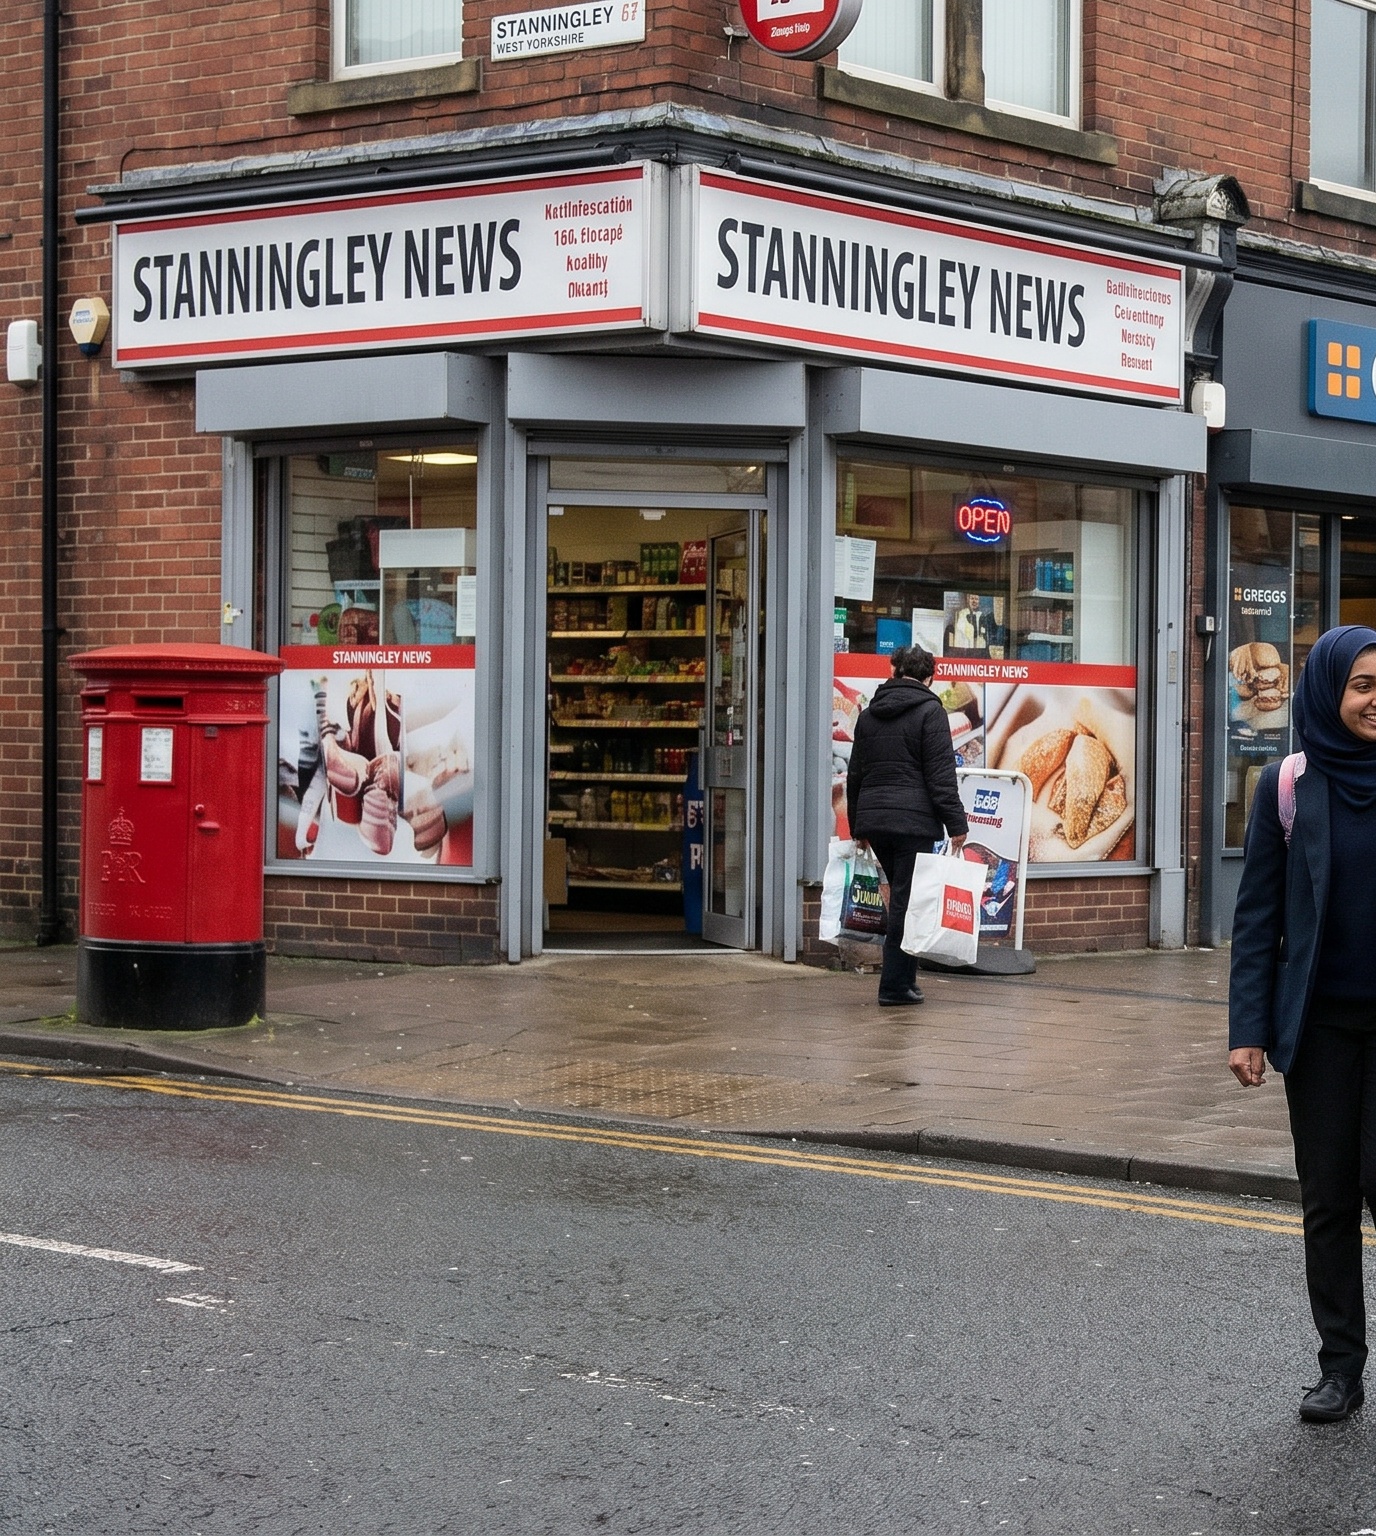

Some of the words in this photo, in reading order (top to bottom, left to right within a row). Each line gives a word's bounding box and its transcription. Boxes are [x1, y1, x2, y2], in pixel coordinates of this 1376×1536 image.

[497, 6, 613, 39] STANNINGLEY
[497, 40, 524, 54] WEST
[527, 32, 584, 51] YORKSHIRE
[133, 231, 392, 323] STANNINGLEY
[404, 218, 522, 300] NEWS
[716, 217, 981, 330] STANNINGLEY
[990, 267, 1086, 348] NEWS
[958, 506, 1011, 534] OPEN
[1243, 588, 1287, 604] GREGGS
[333, 651, 401, 664] STANNINGLEY
[402, 651, 432, 664] NEWS
[937, 663, 1001, 678] STANNINGLEY
[1001, 665, 1029, 679] NEWS
